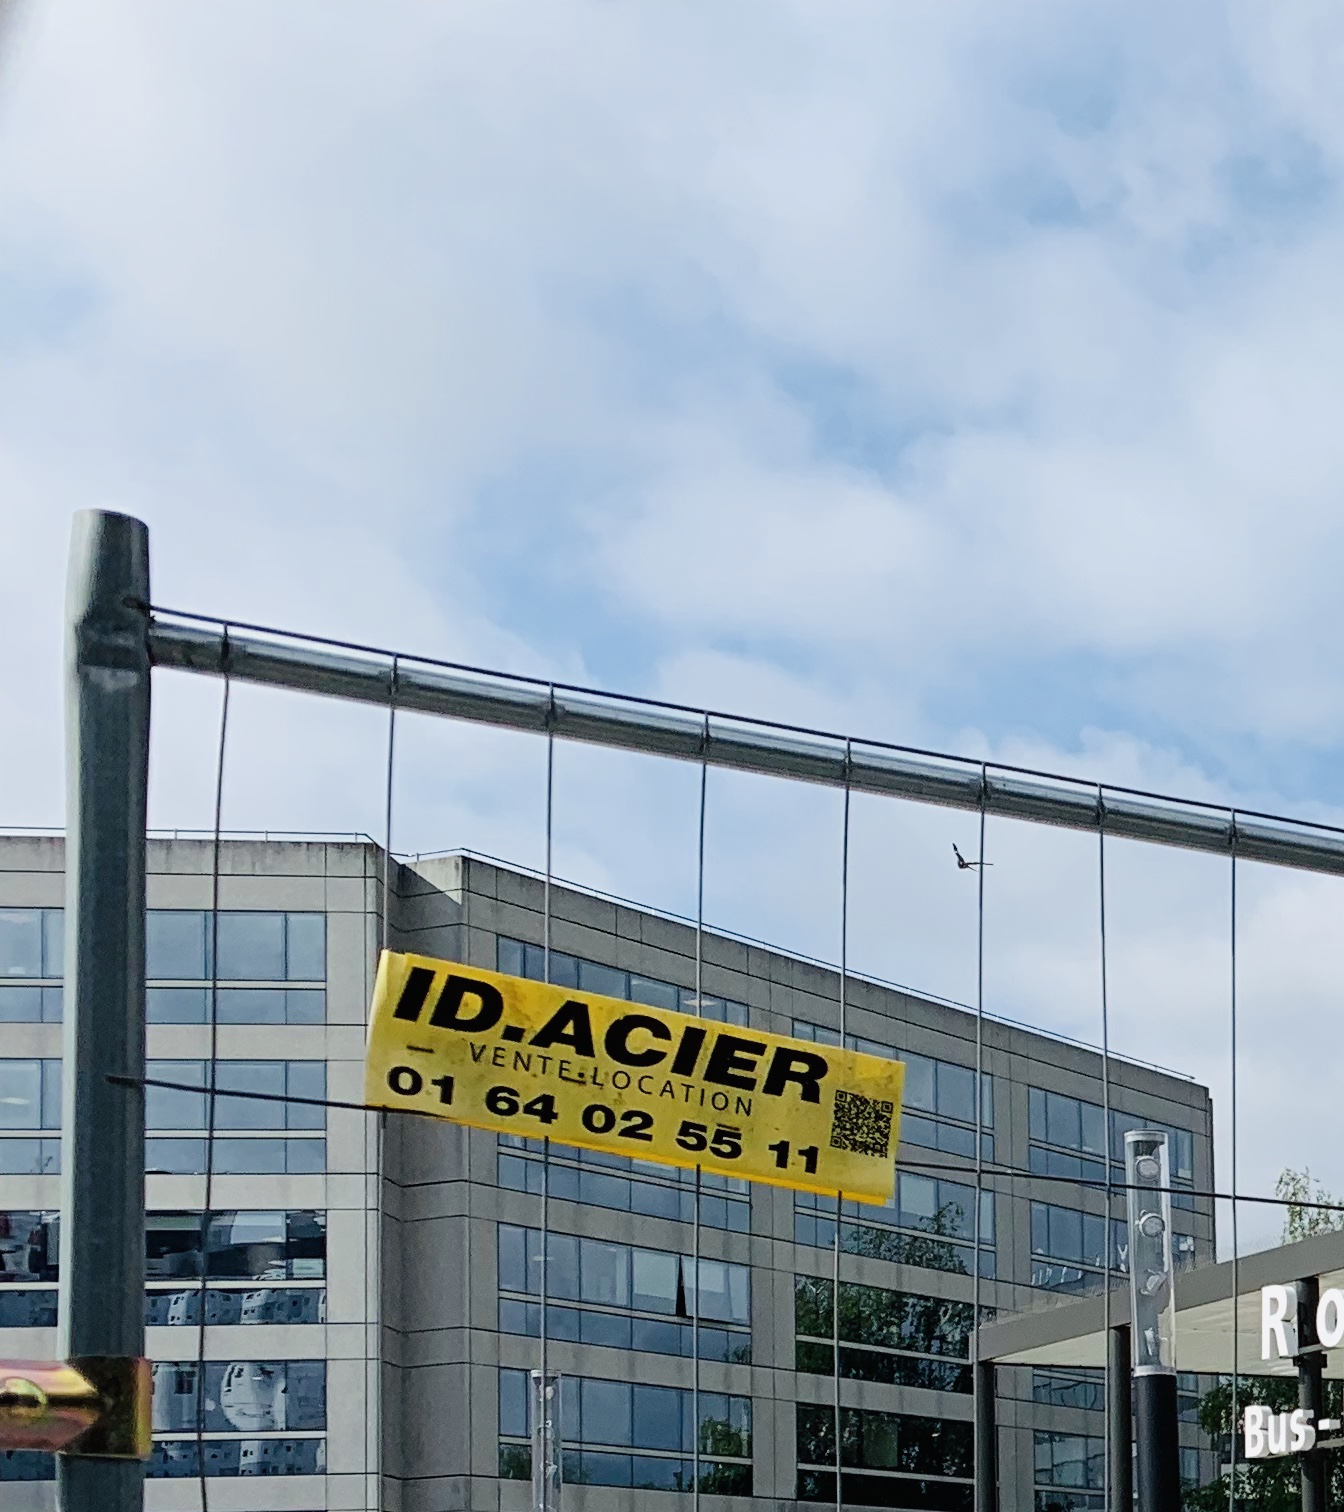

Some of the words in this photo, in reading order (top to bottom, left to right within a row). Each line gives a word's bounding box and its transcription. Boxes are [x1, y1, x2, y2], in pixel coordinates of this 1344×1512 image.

[393, 966, 829, 1104] ID.ACIER
[387, 1065, 455, 1106] 01
[484, 1085, 559, 1125] 64
[581, 1104, 654, 1142] 02
[675, 1119, 743, 1160] 55
[768, 1139, 819, 1175] 11
[1244, 1404, 1316, 1459] Bus
